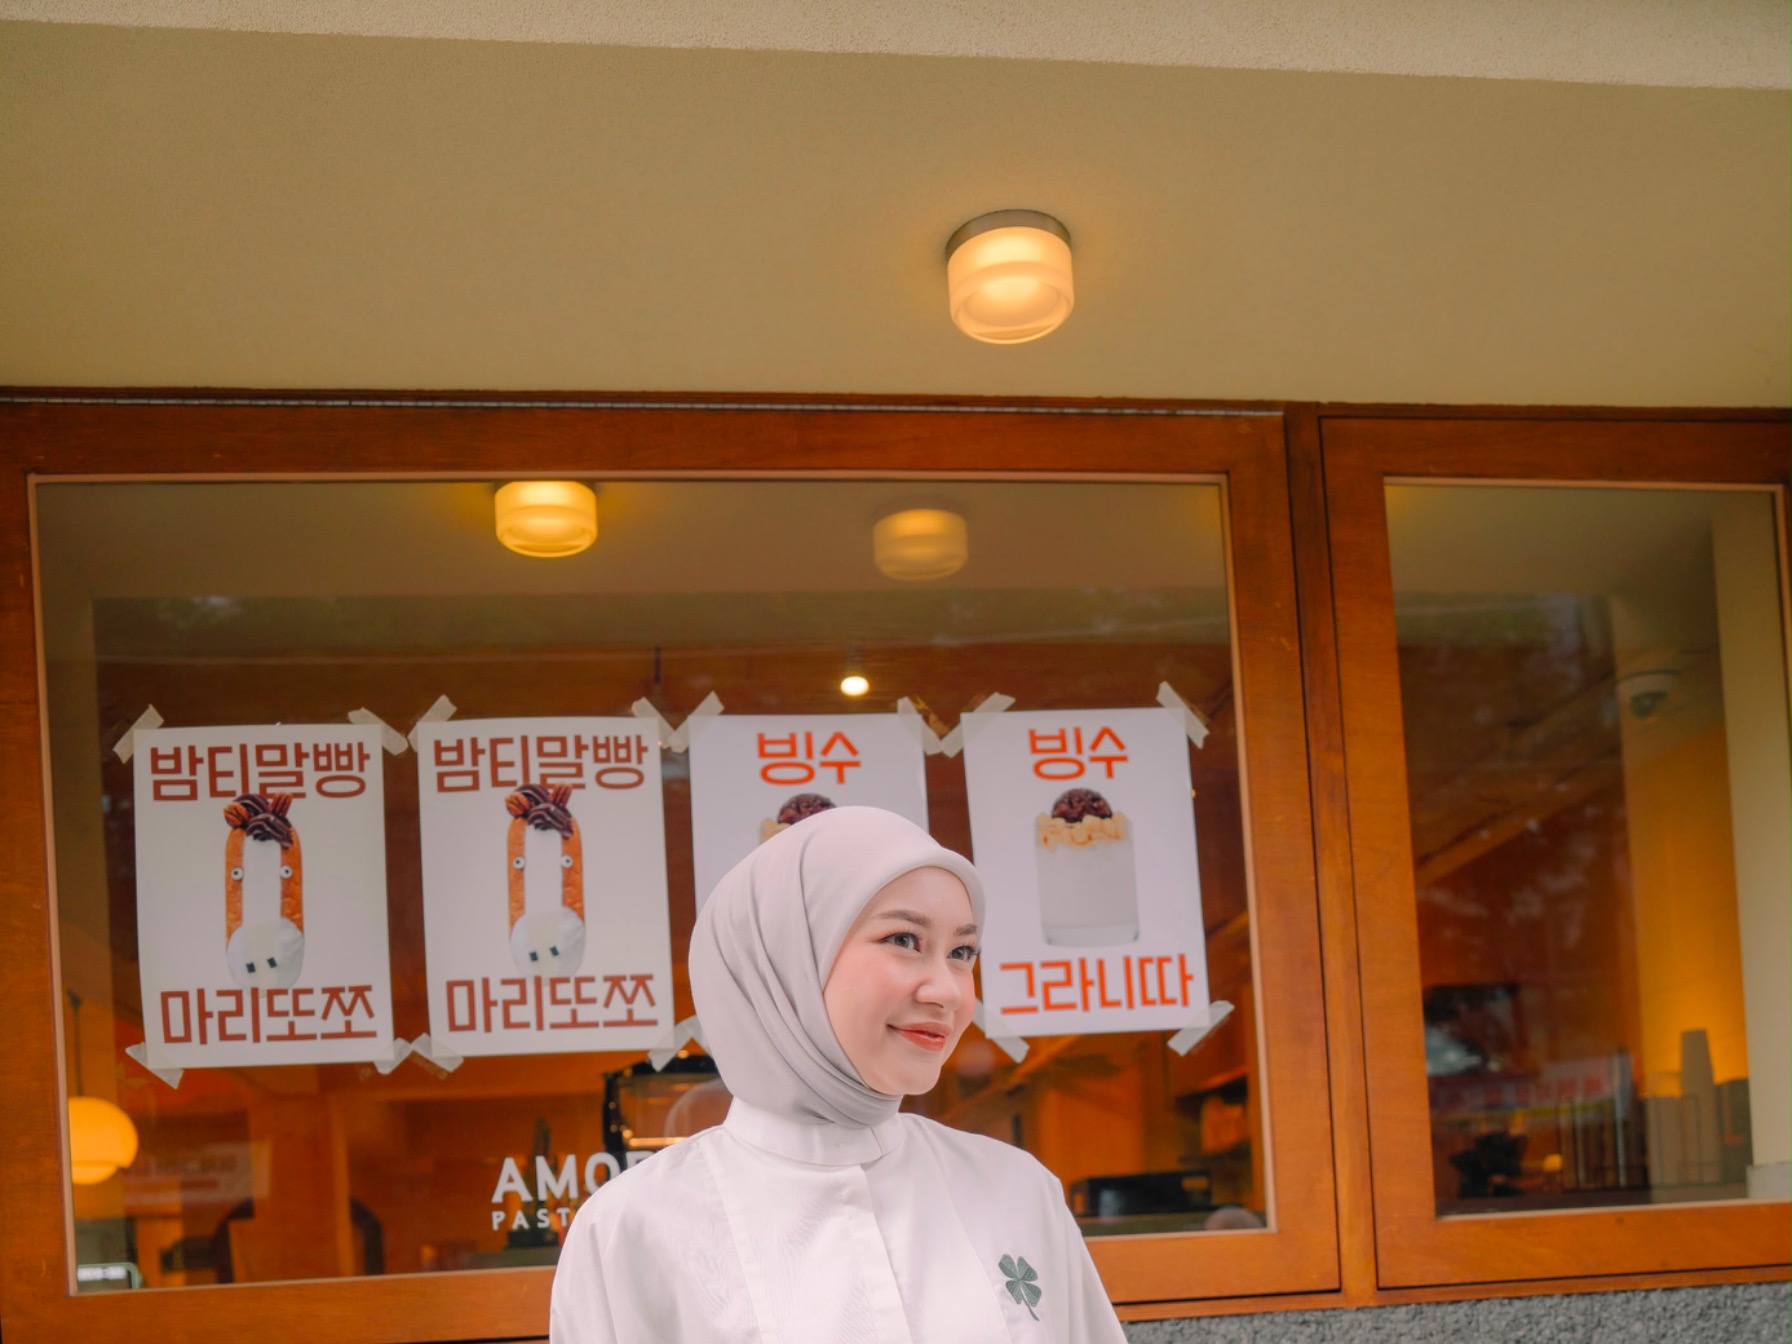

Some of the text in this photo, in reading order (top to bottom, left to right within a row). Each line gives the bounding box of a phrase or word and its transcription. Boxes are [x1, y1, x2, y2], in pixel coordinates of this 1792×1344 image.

[150, 742, 370, 801] 밤티말빵
[433, 734, 648, 793] 밤티말빵
[756, 731, 861, 786] 빙수
[1028, 726, 1129, 781] 빙수
[446, 974, 658, 1032] 마리또쪼
[1000, 953, 1194, 1015] 그라니따
[160, 985, 377, 1044] 마리또쪼
